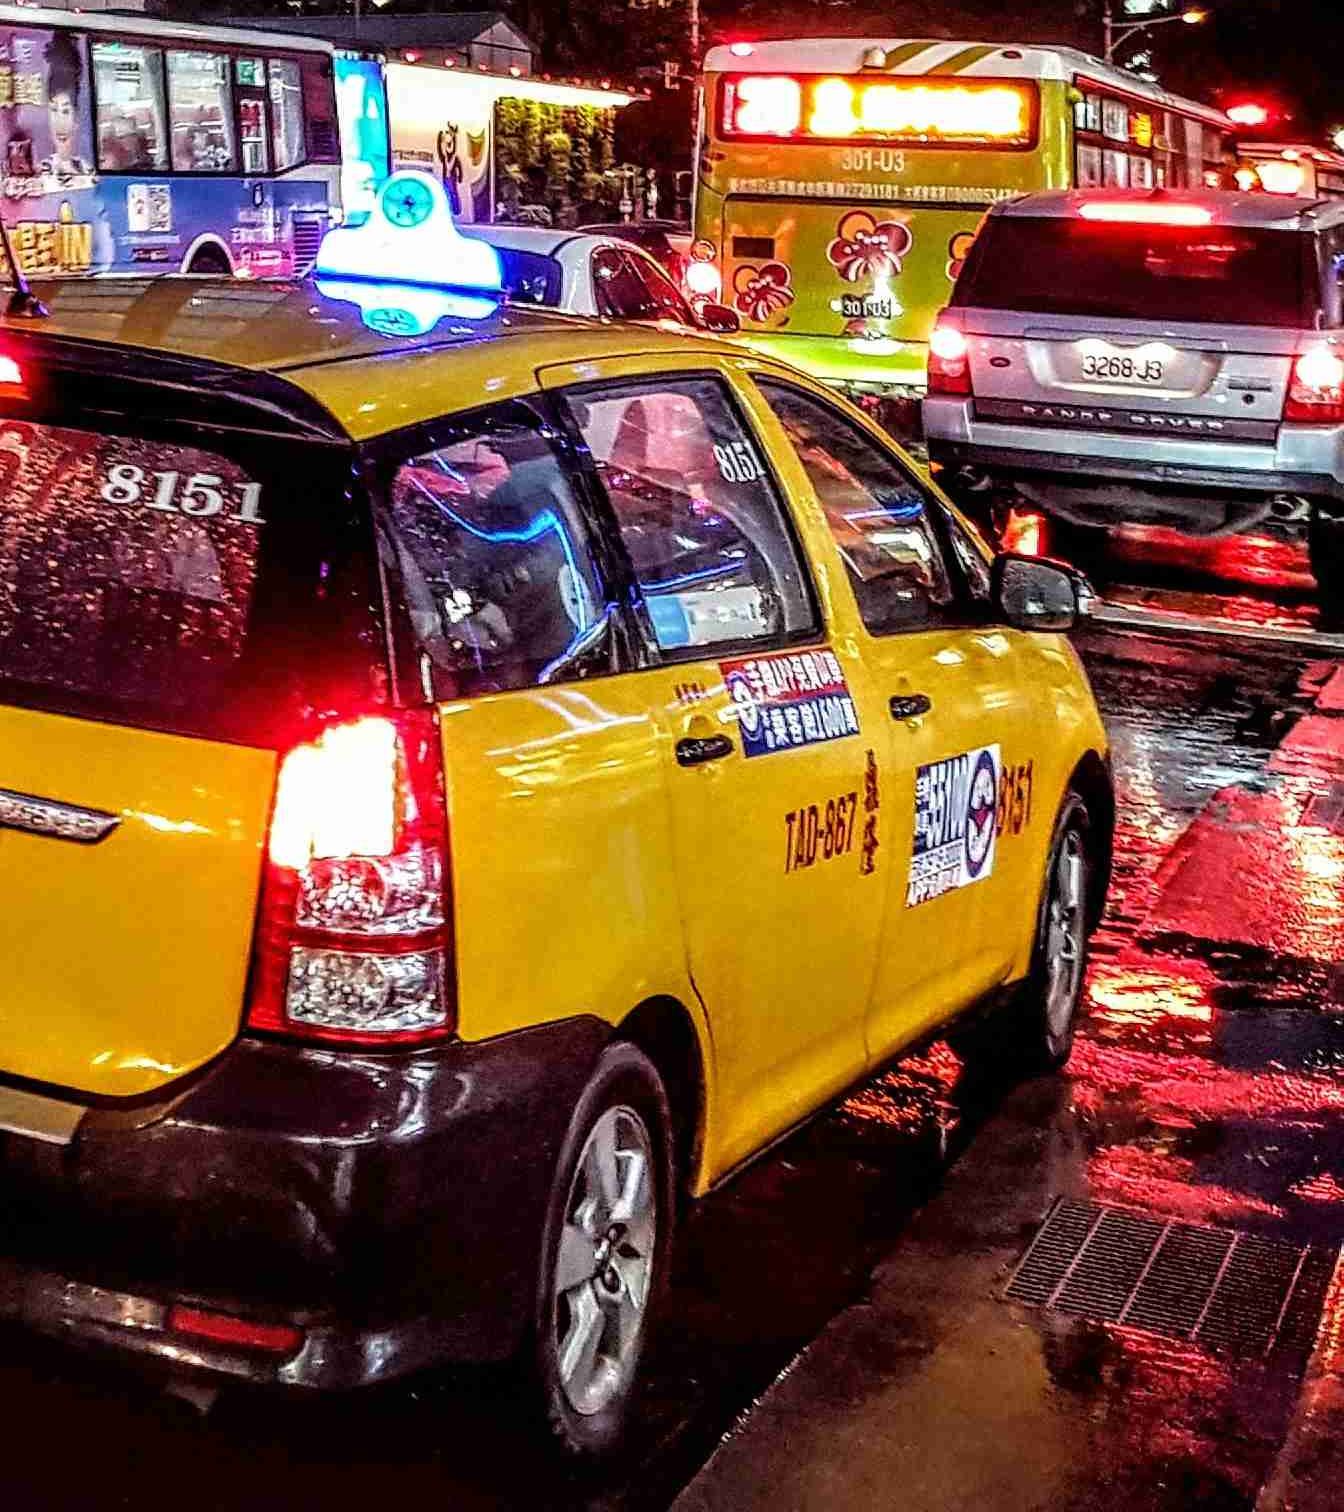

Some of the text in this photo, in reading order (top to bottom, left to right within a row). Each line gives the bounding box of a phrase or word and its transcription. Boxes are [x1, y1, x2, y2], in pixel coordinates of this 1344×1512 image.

[841, 151, 905, 174] 301-U3
[1022, 403, 1226, 431] RANGE ROVER
[712, 439, 767, 483] 8151
[101, 464, 268, 525] 8151
[784, 792, 858, 875] TAD-867
